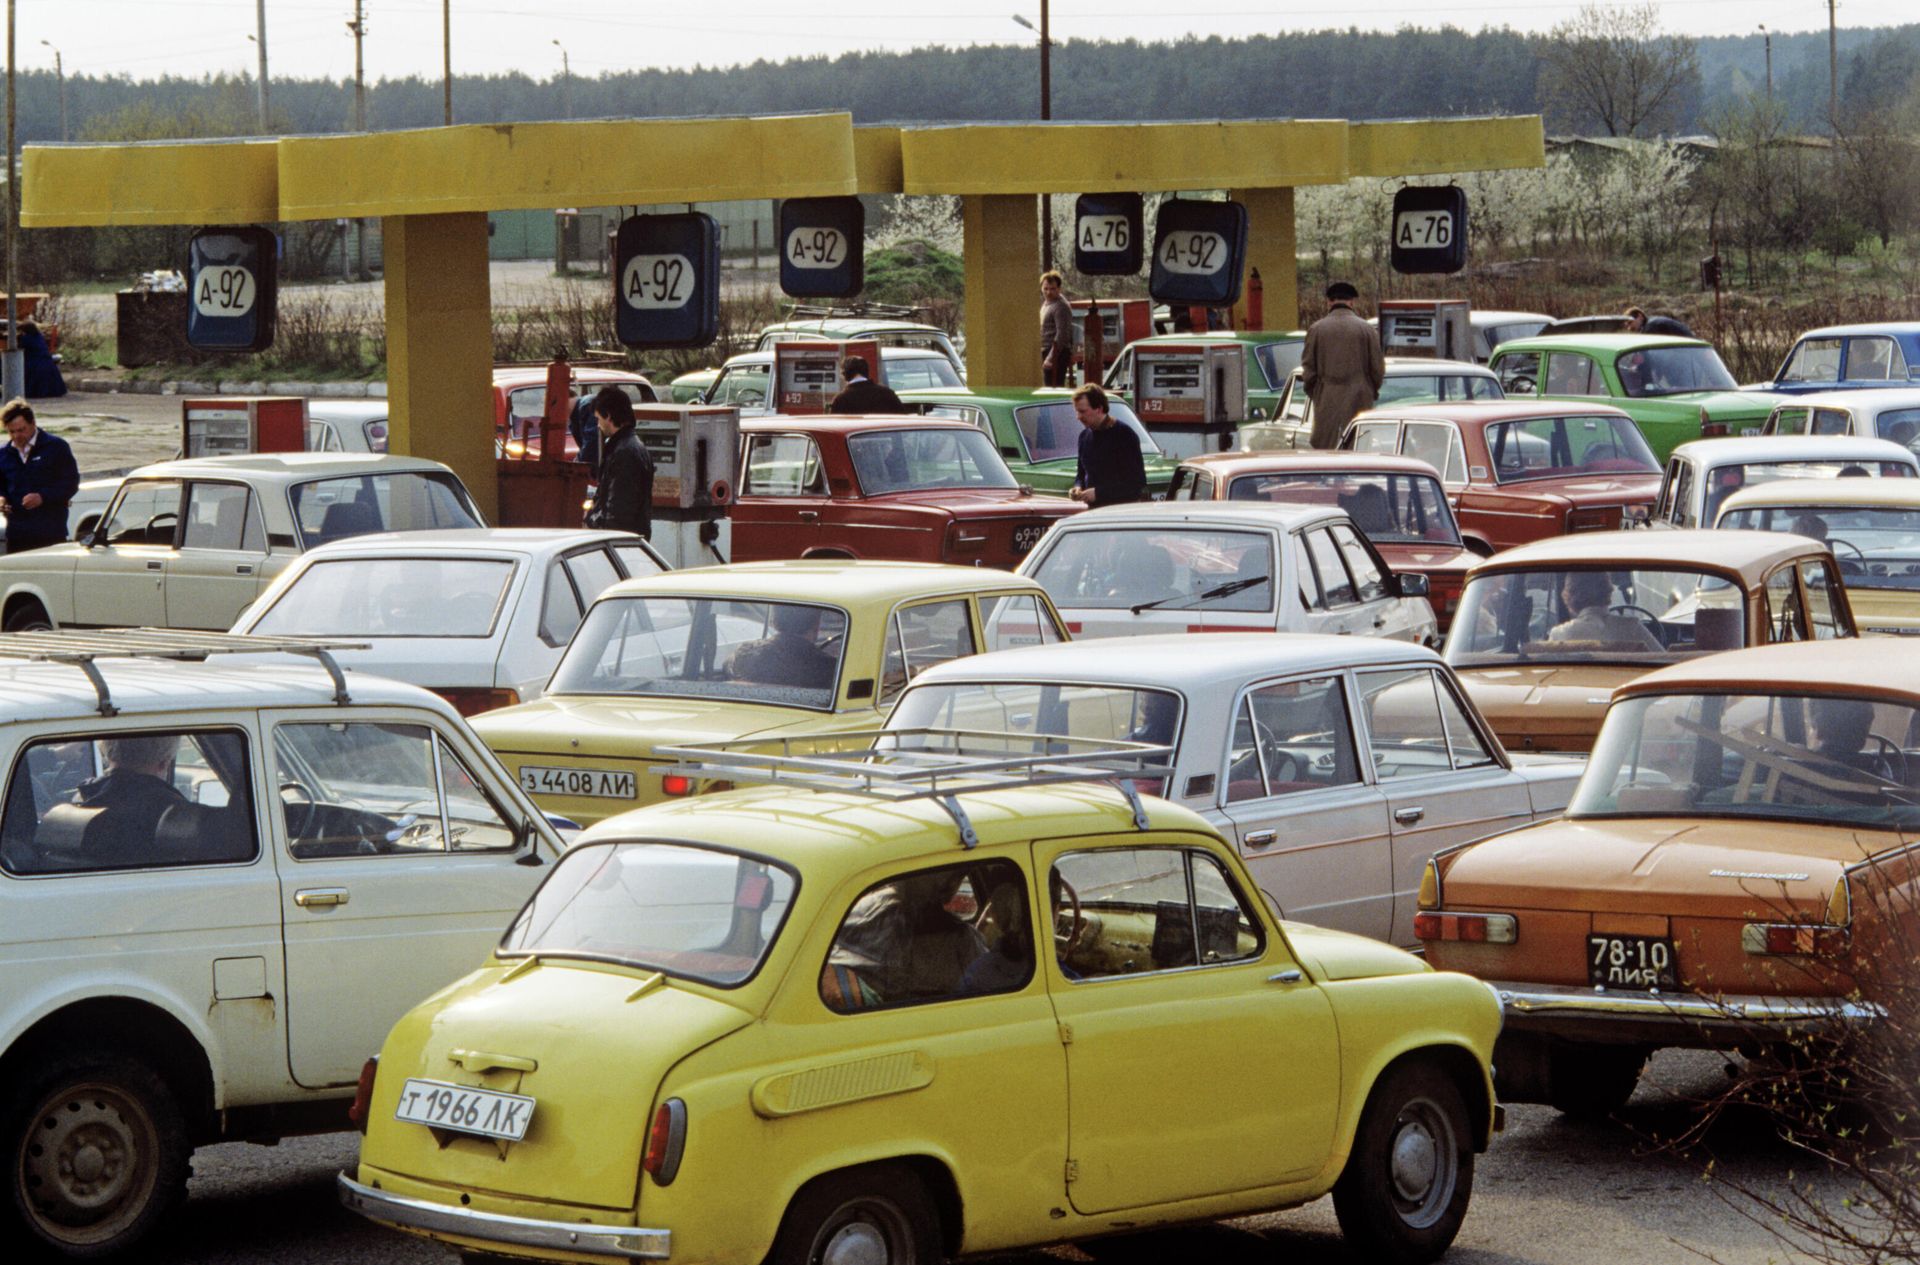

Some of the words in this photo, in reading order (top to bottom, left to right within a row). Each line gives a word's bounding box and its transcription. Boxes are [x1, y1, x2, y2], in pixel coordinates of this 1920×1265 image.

[1082, 220, 1128, 248] А-76
[1400, 215, 1450, 244] А-76
[792, 230, 838, 263] А-92
[1165, 234, 1218, 269] А-92
[200, 269, 246, 309] А-92
[628, 259, 683, 302] А-92
[541, 770, 593, 794] 4408
[600, 773, 630, 796] ЛИ
[1591, 938, 1668, 969] 78-10
[426, 1088, 482, 1127] 1966
[482, 1098, 525, 1134] ЛК
